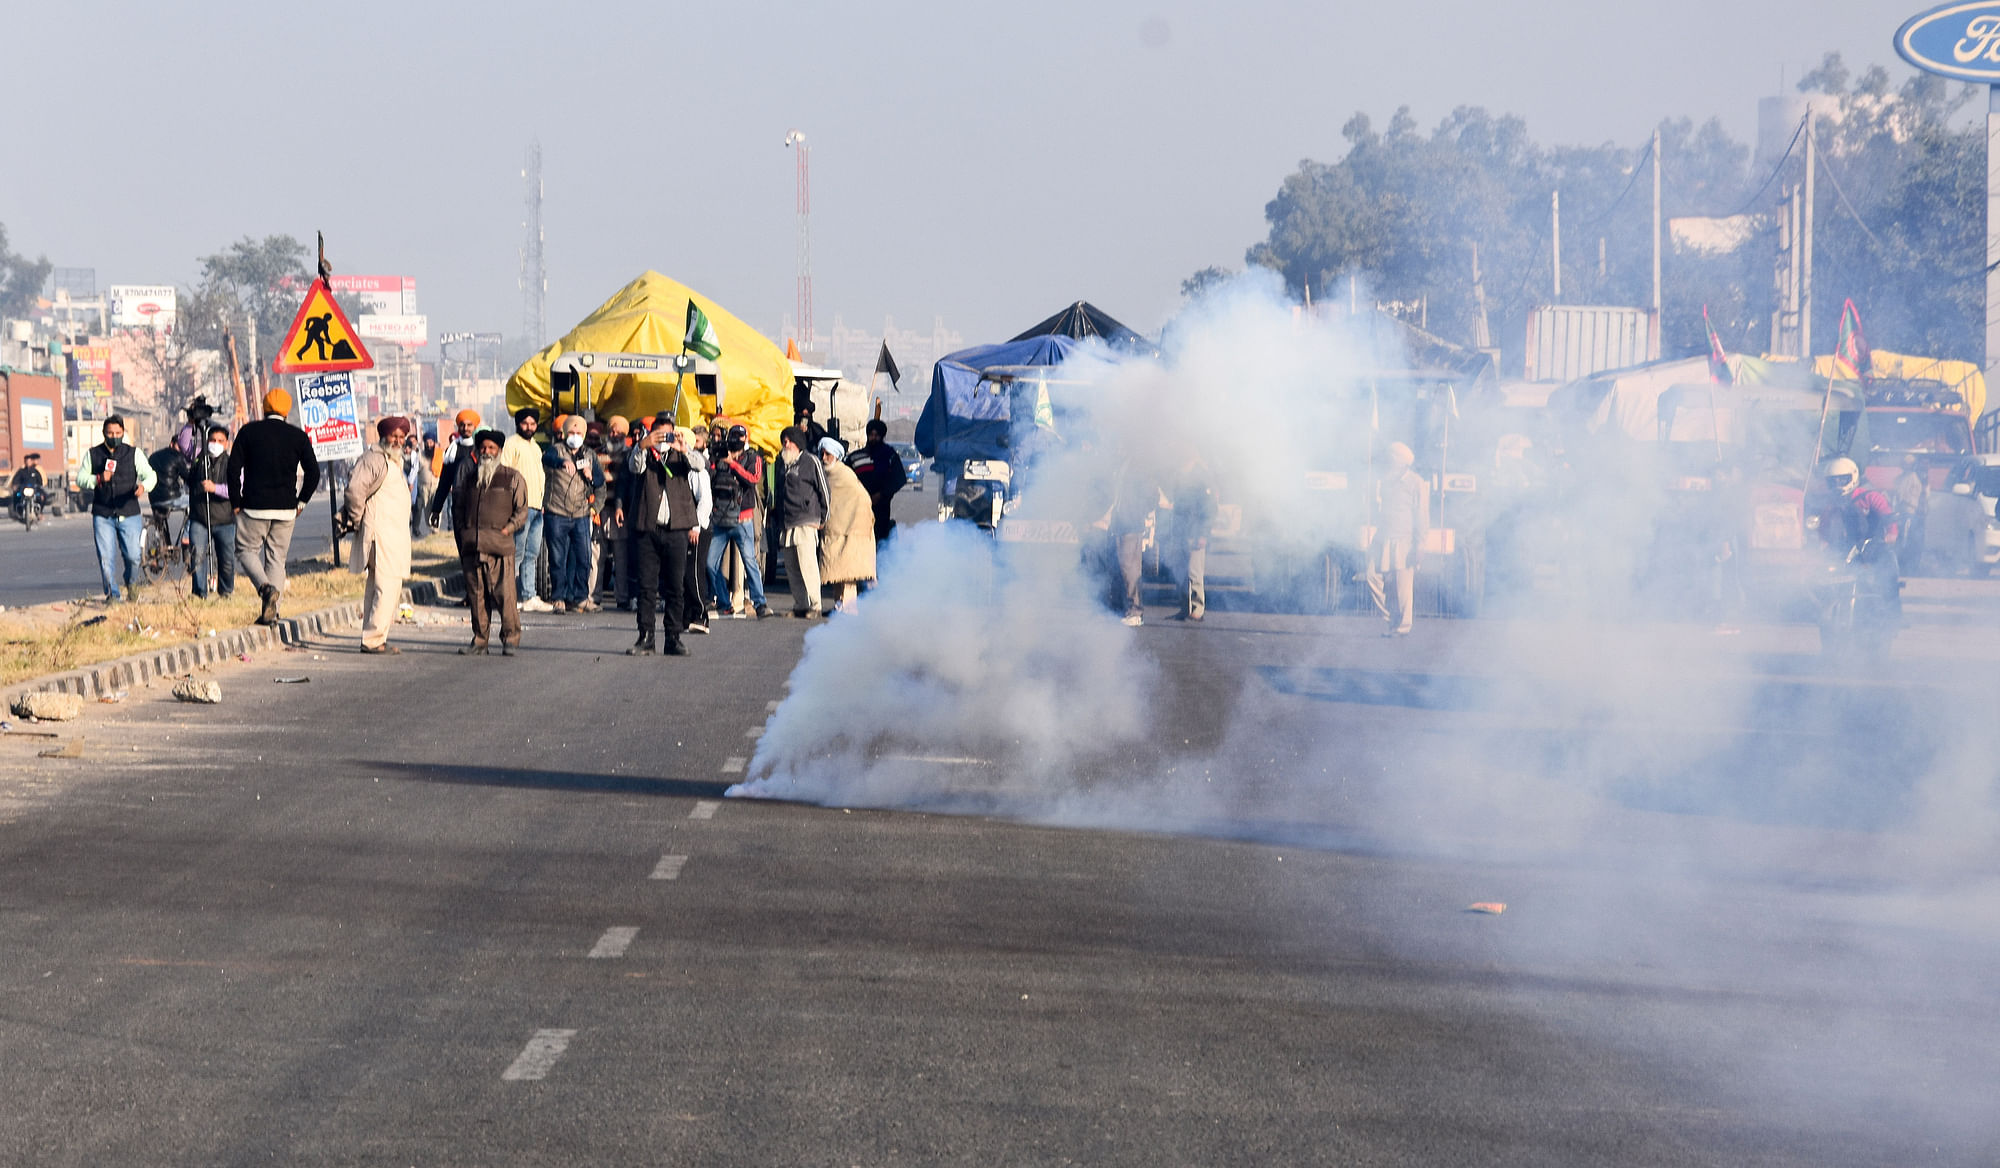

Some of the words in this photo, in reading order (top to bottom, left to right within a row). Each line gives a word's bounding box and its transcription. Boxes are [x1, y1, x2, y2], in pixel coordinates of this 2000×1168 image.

[330, 277, 380, 289] sociates
[302, 382, 349, 399] Reebok
[304, 406, 327, 424] 70%
